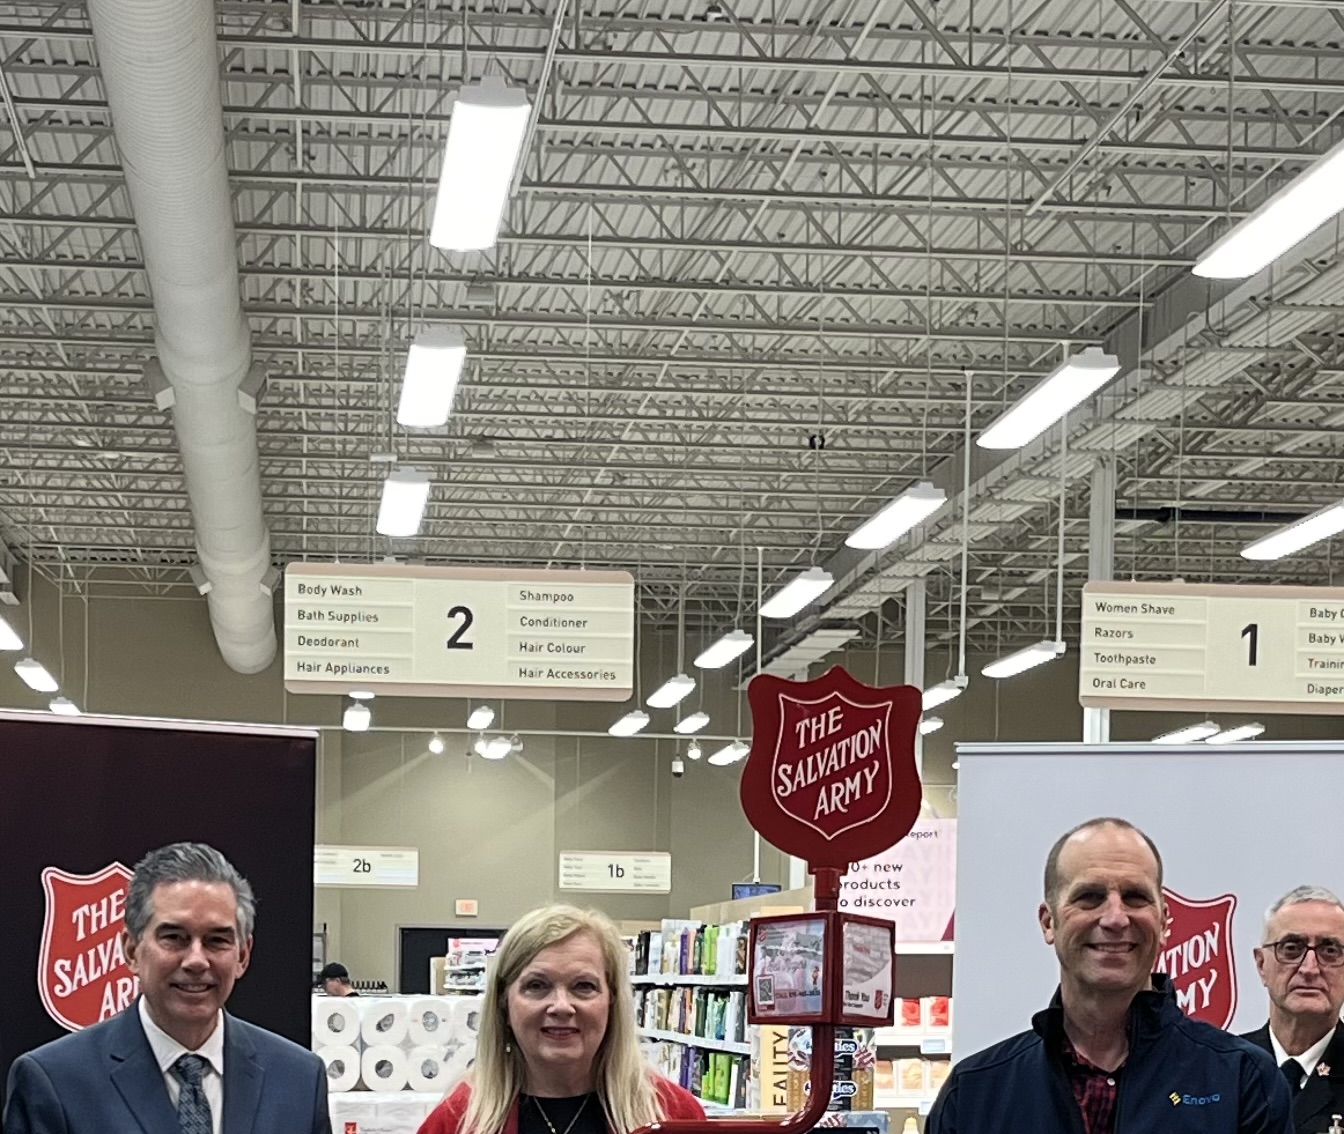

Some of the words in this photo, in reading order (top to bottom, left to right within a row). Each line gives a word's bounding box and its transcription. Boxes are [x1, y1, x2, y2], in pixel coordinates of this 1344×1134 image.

[298, 583, 326, 598] Body
[330, 584, 362, 597] Wash
[519, 590, 574, 605] Shampoo
[1095, 602, 1138, 614] Women
[1140, 603, 1175, 615] Shave
[1309, 607, 1337, 622] Baby
[298, 610, 325, 622] Bath
[328, 611, 379, 625] Supplies
[519, 616, 588, 629] Conditioner
[447, 605, 473, 650] 2
[1094, 627, 1134, 639] Razors
[298, 635, 359, 648] Deodorant
[1241, 623, 1258, 667] 1
[1308, 633, 1336, 647] Baby
[519, 642, 543, 654] Hair
[546, 643, 586, 655] Colour
[1094, 652, 1157, 666] Toothpaste
[296, 661, 321, 674] Hair
[325, 662, 390, 678] Appliances
[518, 668, 543, 681] Hair
[546, 669, 616, 682] Accessories
[1092, 677, 1117, 689] Oral
[1119, 678, 1146, 690] Care
[795, 706, 844, 750] THE
[776, 718, 882, 797] SALVATION
[812, 760, 880, 821] ARMY
[352, 858, 371, 873] 2b
[607, 862, 625, 878] 1b
[874, 864, 903, 876] new
[839, 878, 901, 892] roducts
[855, 895, 916, 909] discover
[71, 888, 128, 942] THE
[1155, 921, 1220, 980] ATION
[53, 931, 127, 998] SALVA
[1175, 968, 1218, 1016] MY
